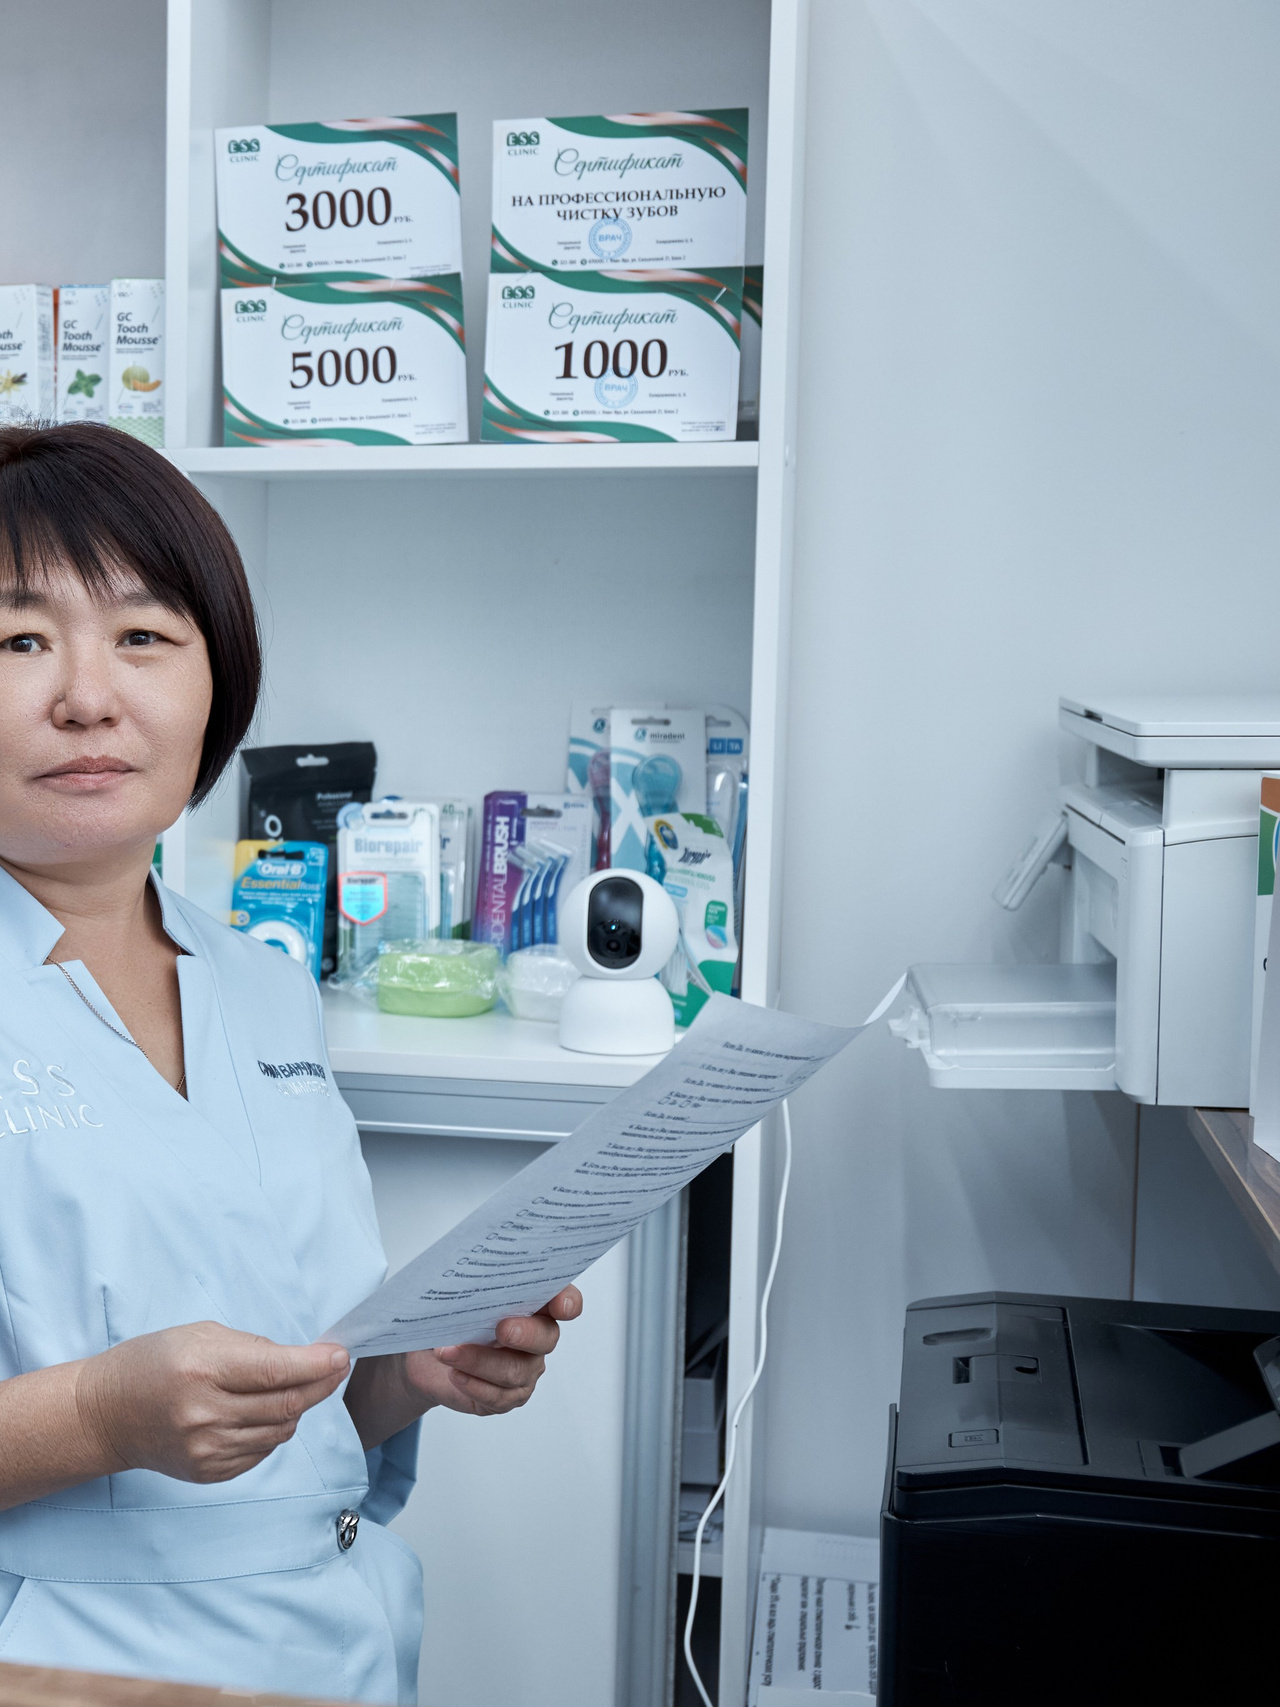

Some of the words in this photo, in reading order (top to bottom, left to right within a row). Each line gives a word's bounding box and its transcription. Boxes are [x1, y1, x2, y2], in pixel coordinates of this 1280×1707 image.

[507, 132, 539, 146] ESS
[229, 139, 260, 153] ESS
[230, 154, 259, 162] CLINIC
[512, 195, 534, 207] НА
[539, 186, 726, 206] ПРОФЕССИОНАЛЬНУЮ
[285, 186, 392, 232] 3000
[557, 206, 622, 223] ЧИСТКУ
[627, 205, 678, 220] ЗУБОВ
[502, 286, 535, 299] ESS
[235, 300, 267, 314] ESS
[117, 312, 132, 321] GC
[63, 320, 78, 329] GC
[117, 324, 148, 333] Tooth
[63, 331, 92, 340] Tooth
[116, 336, 158, 345] Mousse
[62, 343, 101, 352] Mousse
[555, 338, 668, 380] 1000
[290, 346, 397, 389] 5000
[650, 731, 685, 740] miradent
[354, 838, 423, 856] Biorepair
[261, 863, 303, 876] Oral-B
